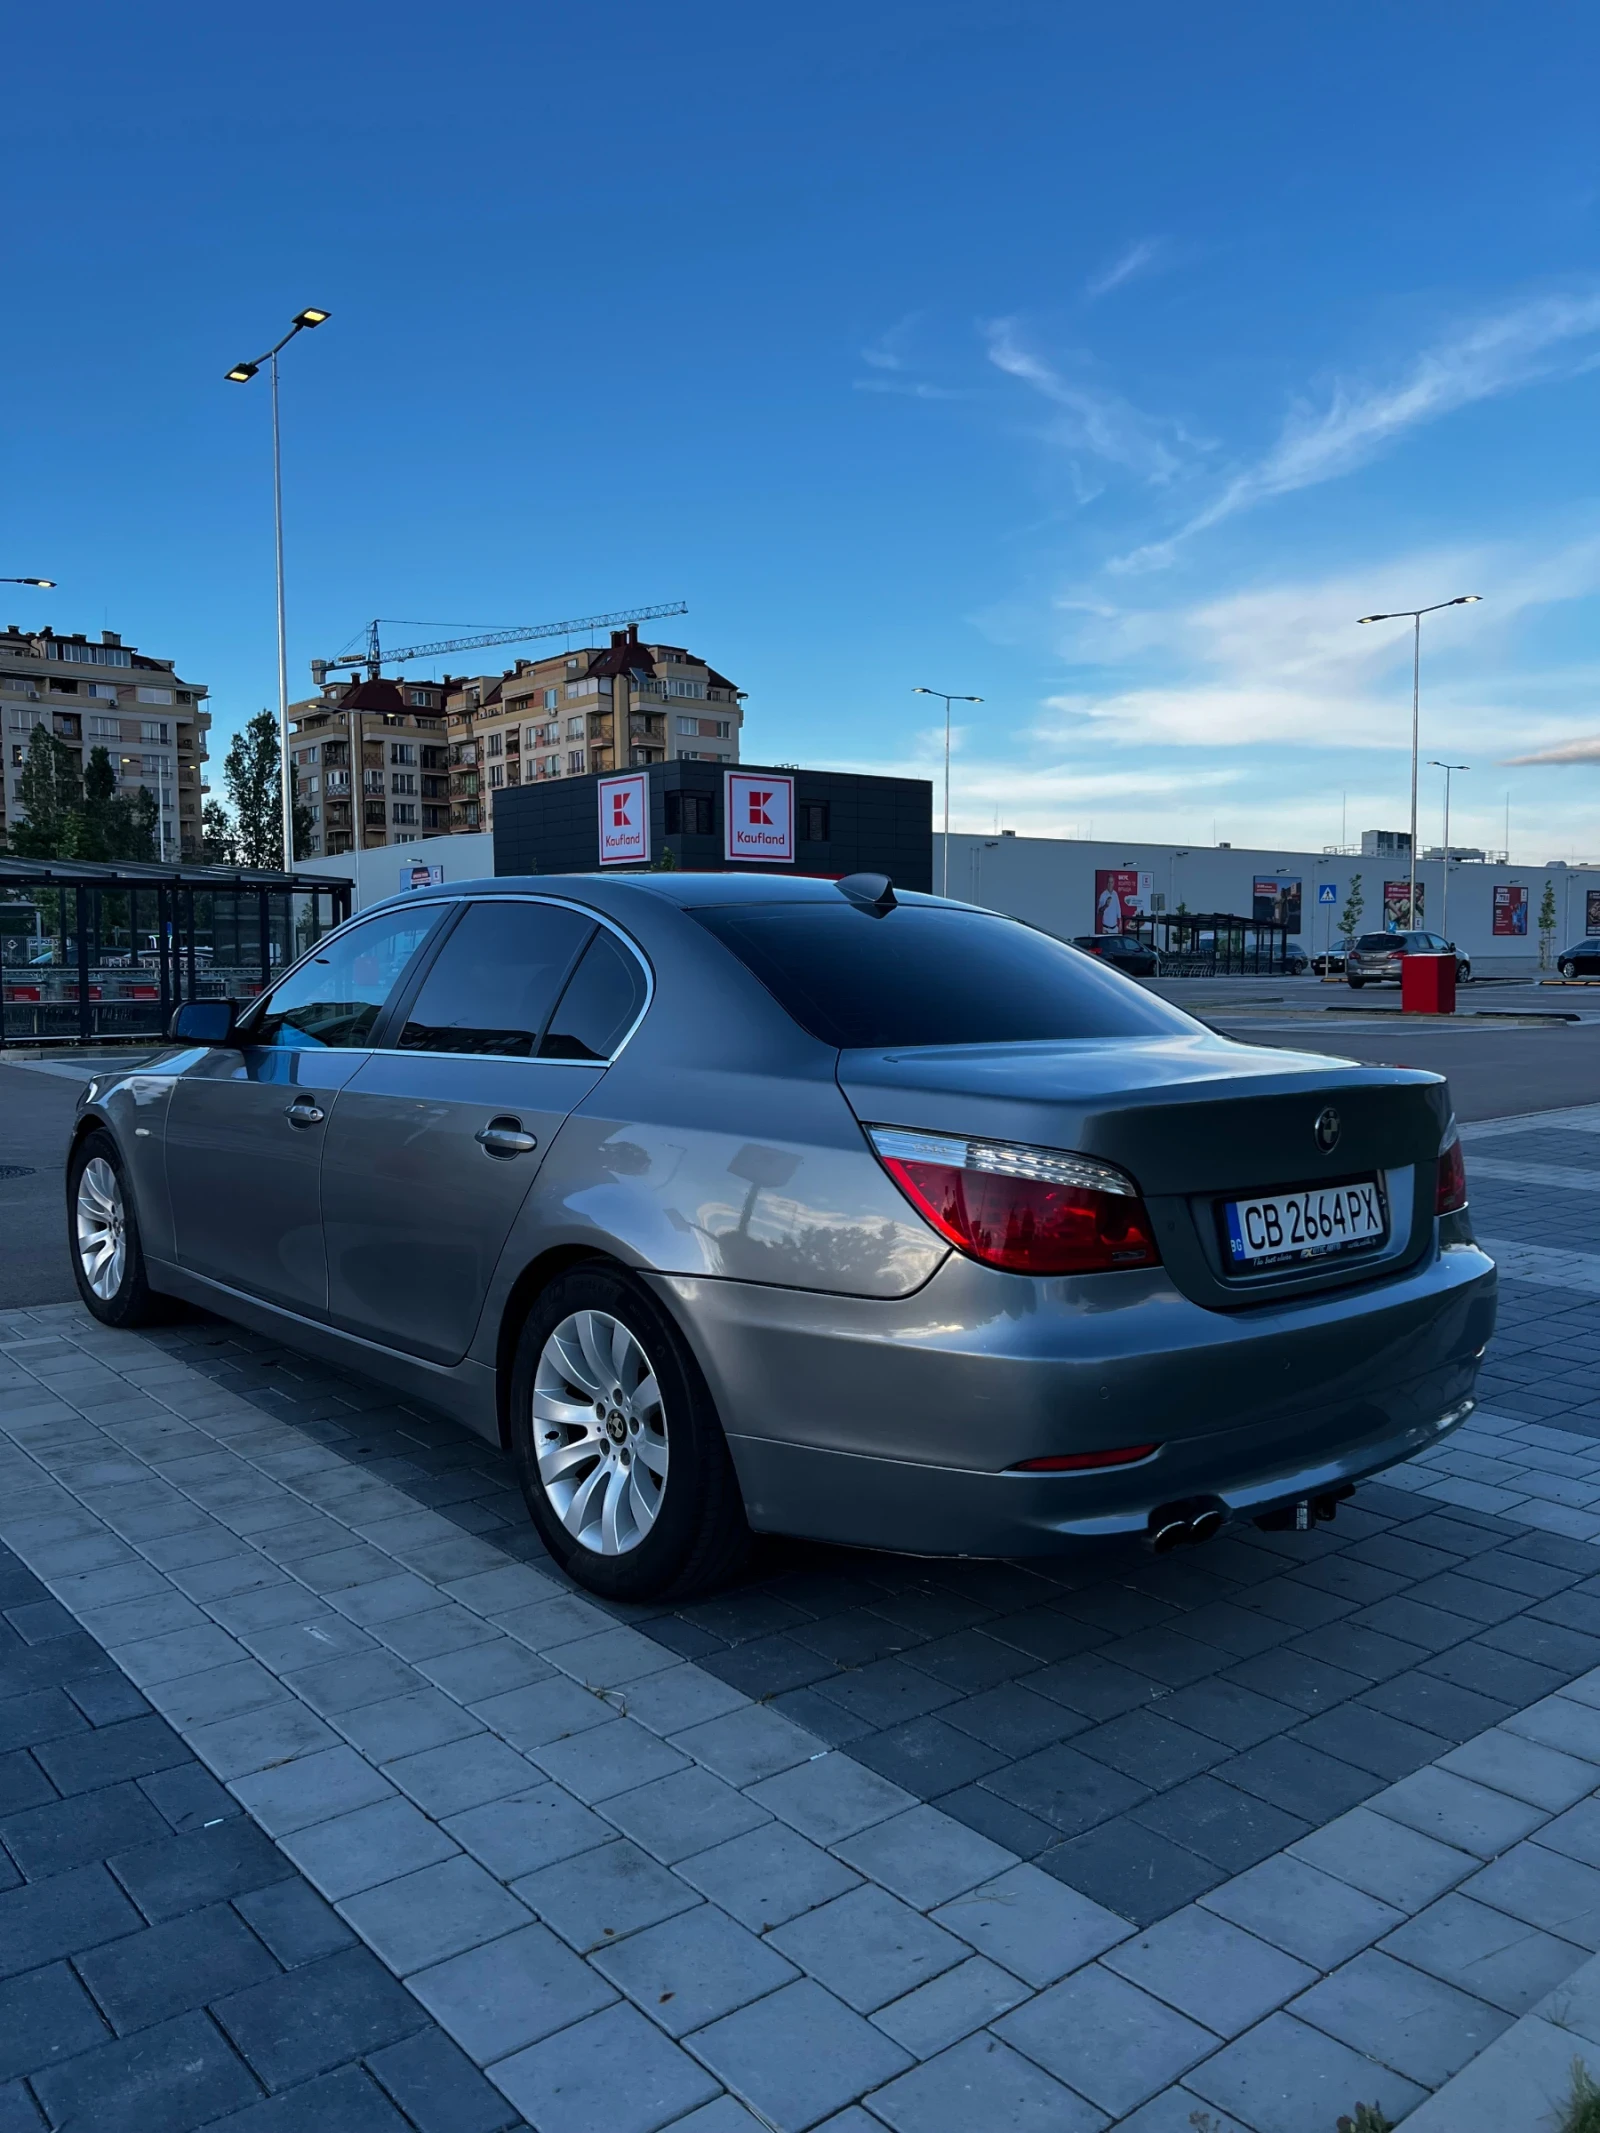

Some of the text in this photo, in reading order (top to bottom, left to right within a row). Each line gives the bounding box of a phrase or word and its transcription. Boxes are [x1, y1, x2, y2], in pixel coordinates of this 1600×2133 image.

[605, 833, 640, 847] Kaufland
[737, 831, 785, 845] Kaufland
[1230, 1238, 1243, 1253] BG
